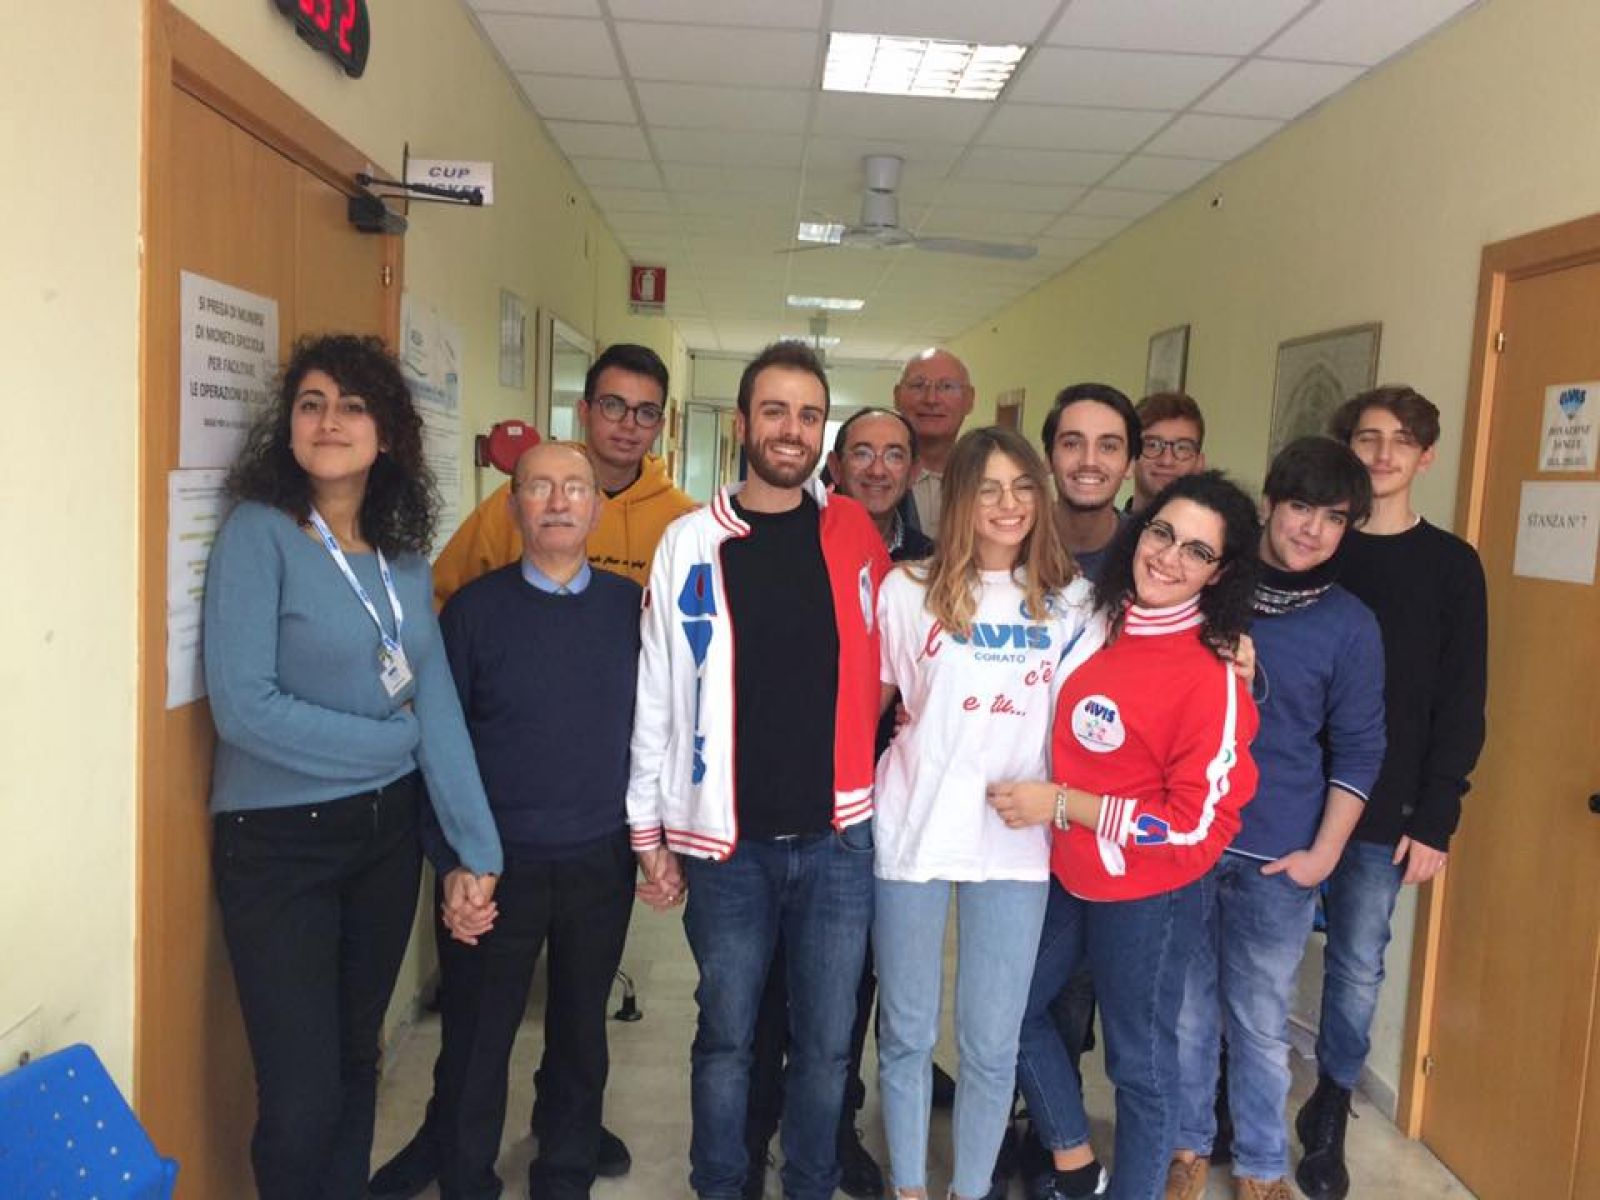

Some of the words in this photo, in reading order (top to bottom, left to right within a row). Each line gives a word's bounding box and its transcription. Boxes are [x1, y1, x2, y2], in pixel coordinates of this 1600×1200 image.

[428, 166, 470, 178] CUP
[208, 354, 223, 371] PER
[190, 380, 199, 397] LE
[1527, 511, 1565, 529] STANZA
[974, 651, 1026, 665] CORATO
[963, 695, 981, 711] e
[1084, 699, 1117, 724] AVIS
